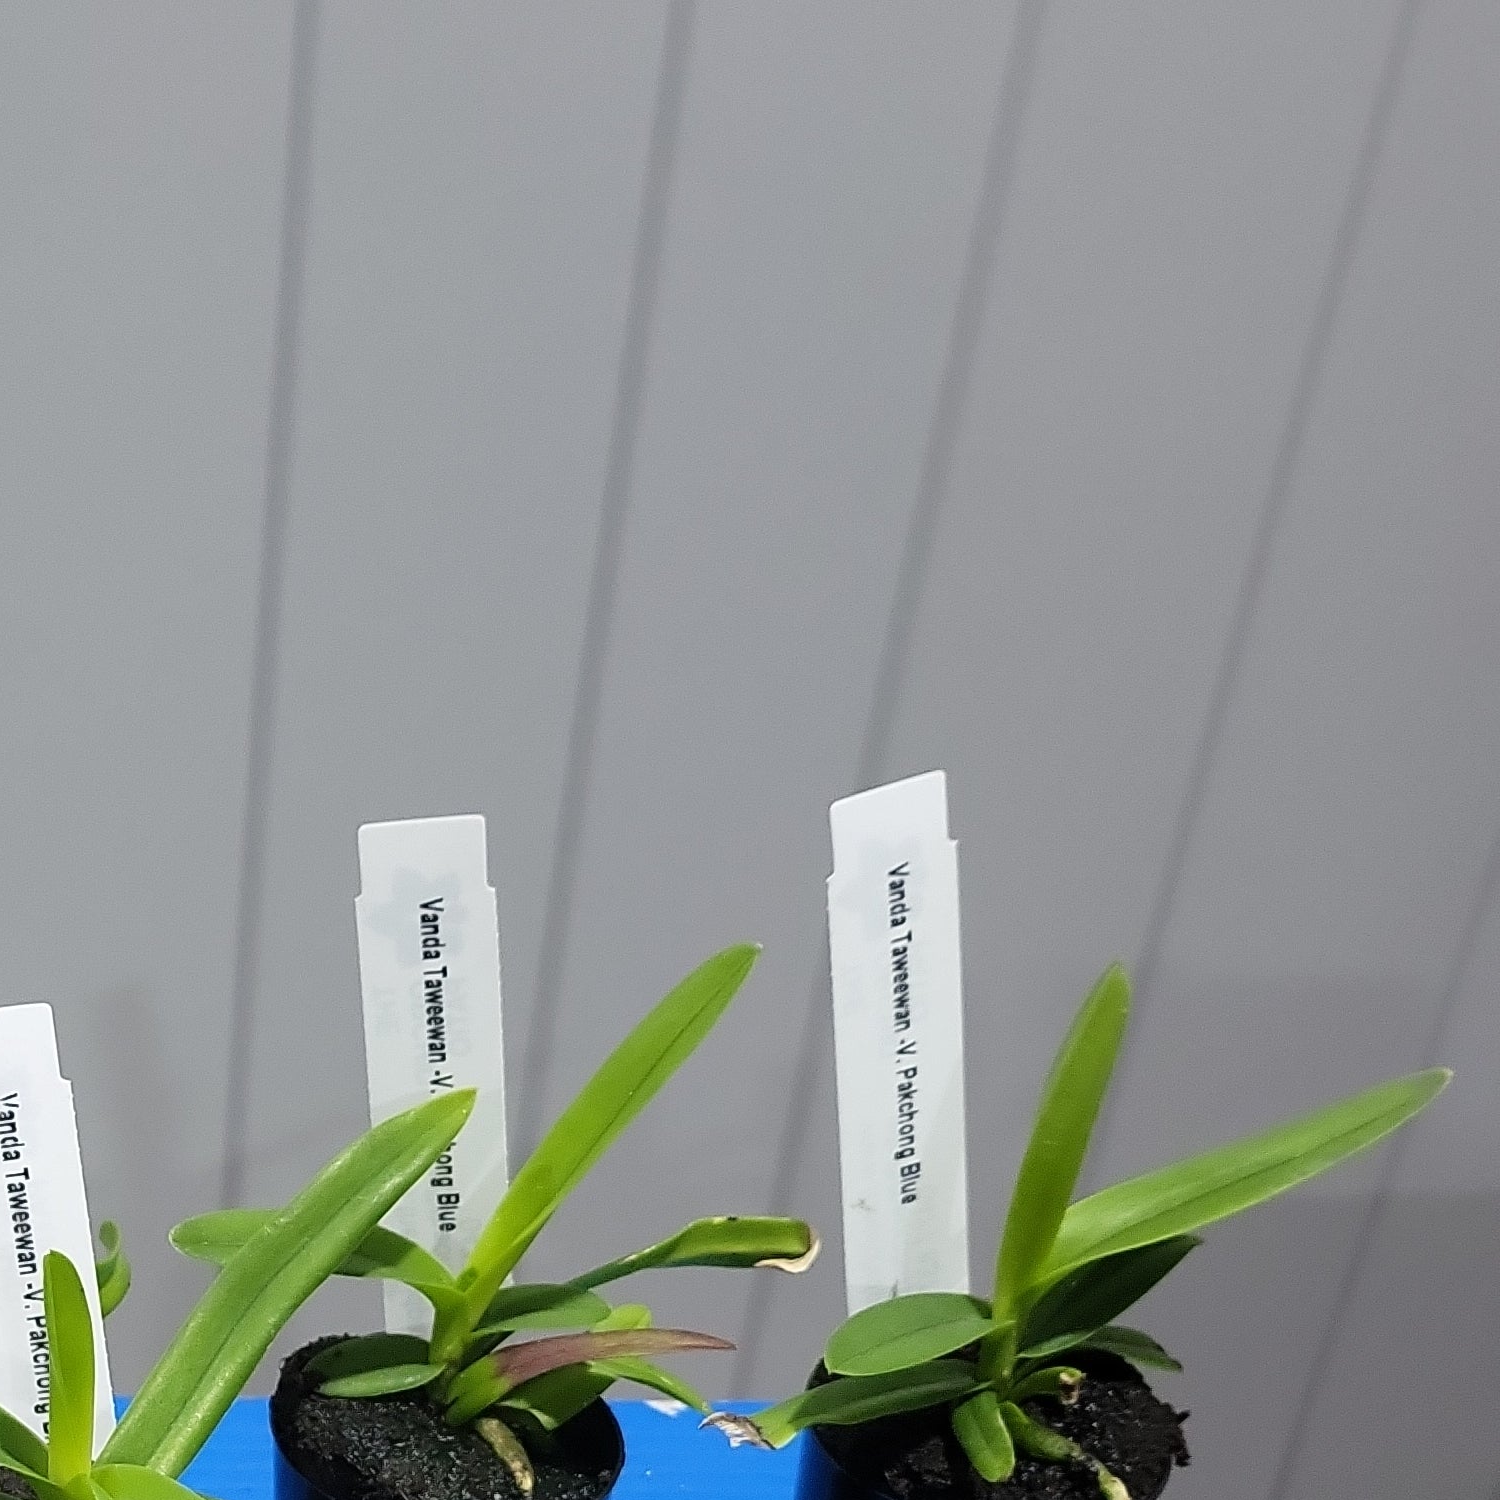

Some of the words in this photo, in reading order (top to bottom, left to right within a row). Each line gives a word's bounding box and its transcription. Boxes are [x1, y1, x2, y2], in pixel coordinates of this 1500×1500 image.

[419, 897, 444, 961] Vanda
[888, 861, 911, 928] Vanda
[423, 965, 448, 1064] Taweewan
[891, 930, 913, 1033] Taweewan
[893, 1066, 919, 1159] Pakchong
[5, 1167, 38, 1276] Taweewan
[436, 1192, 461, 1233] Blue
[900, 1159, 921, 1205] Blue
